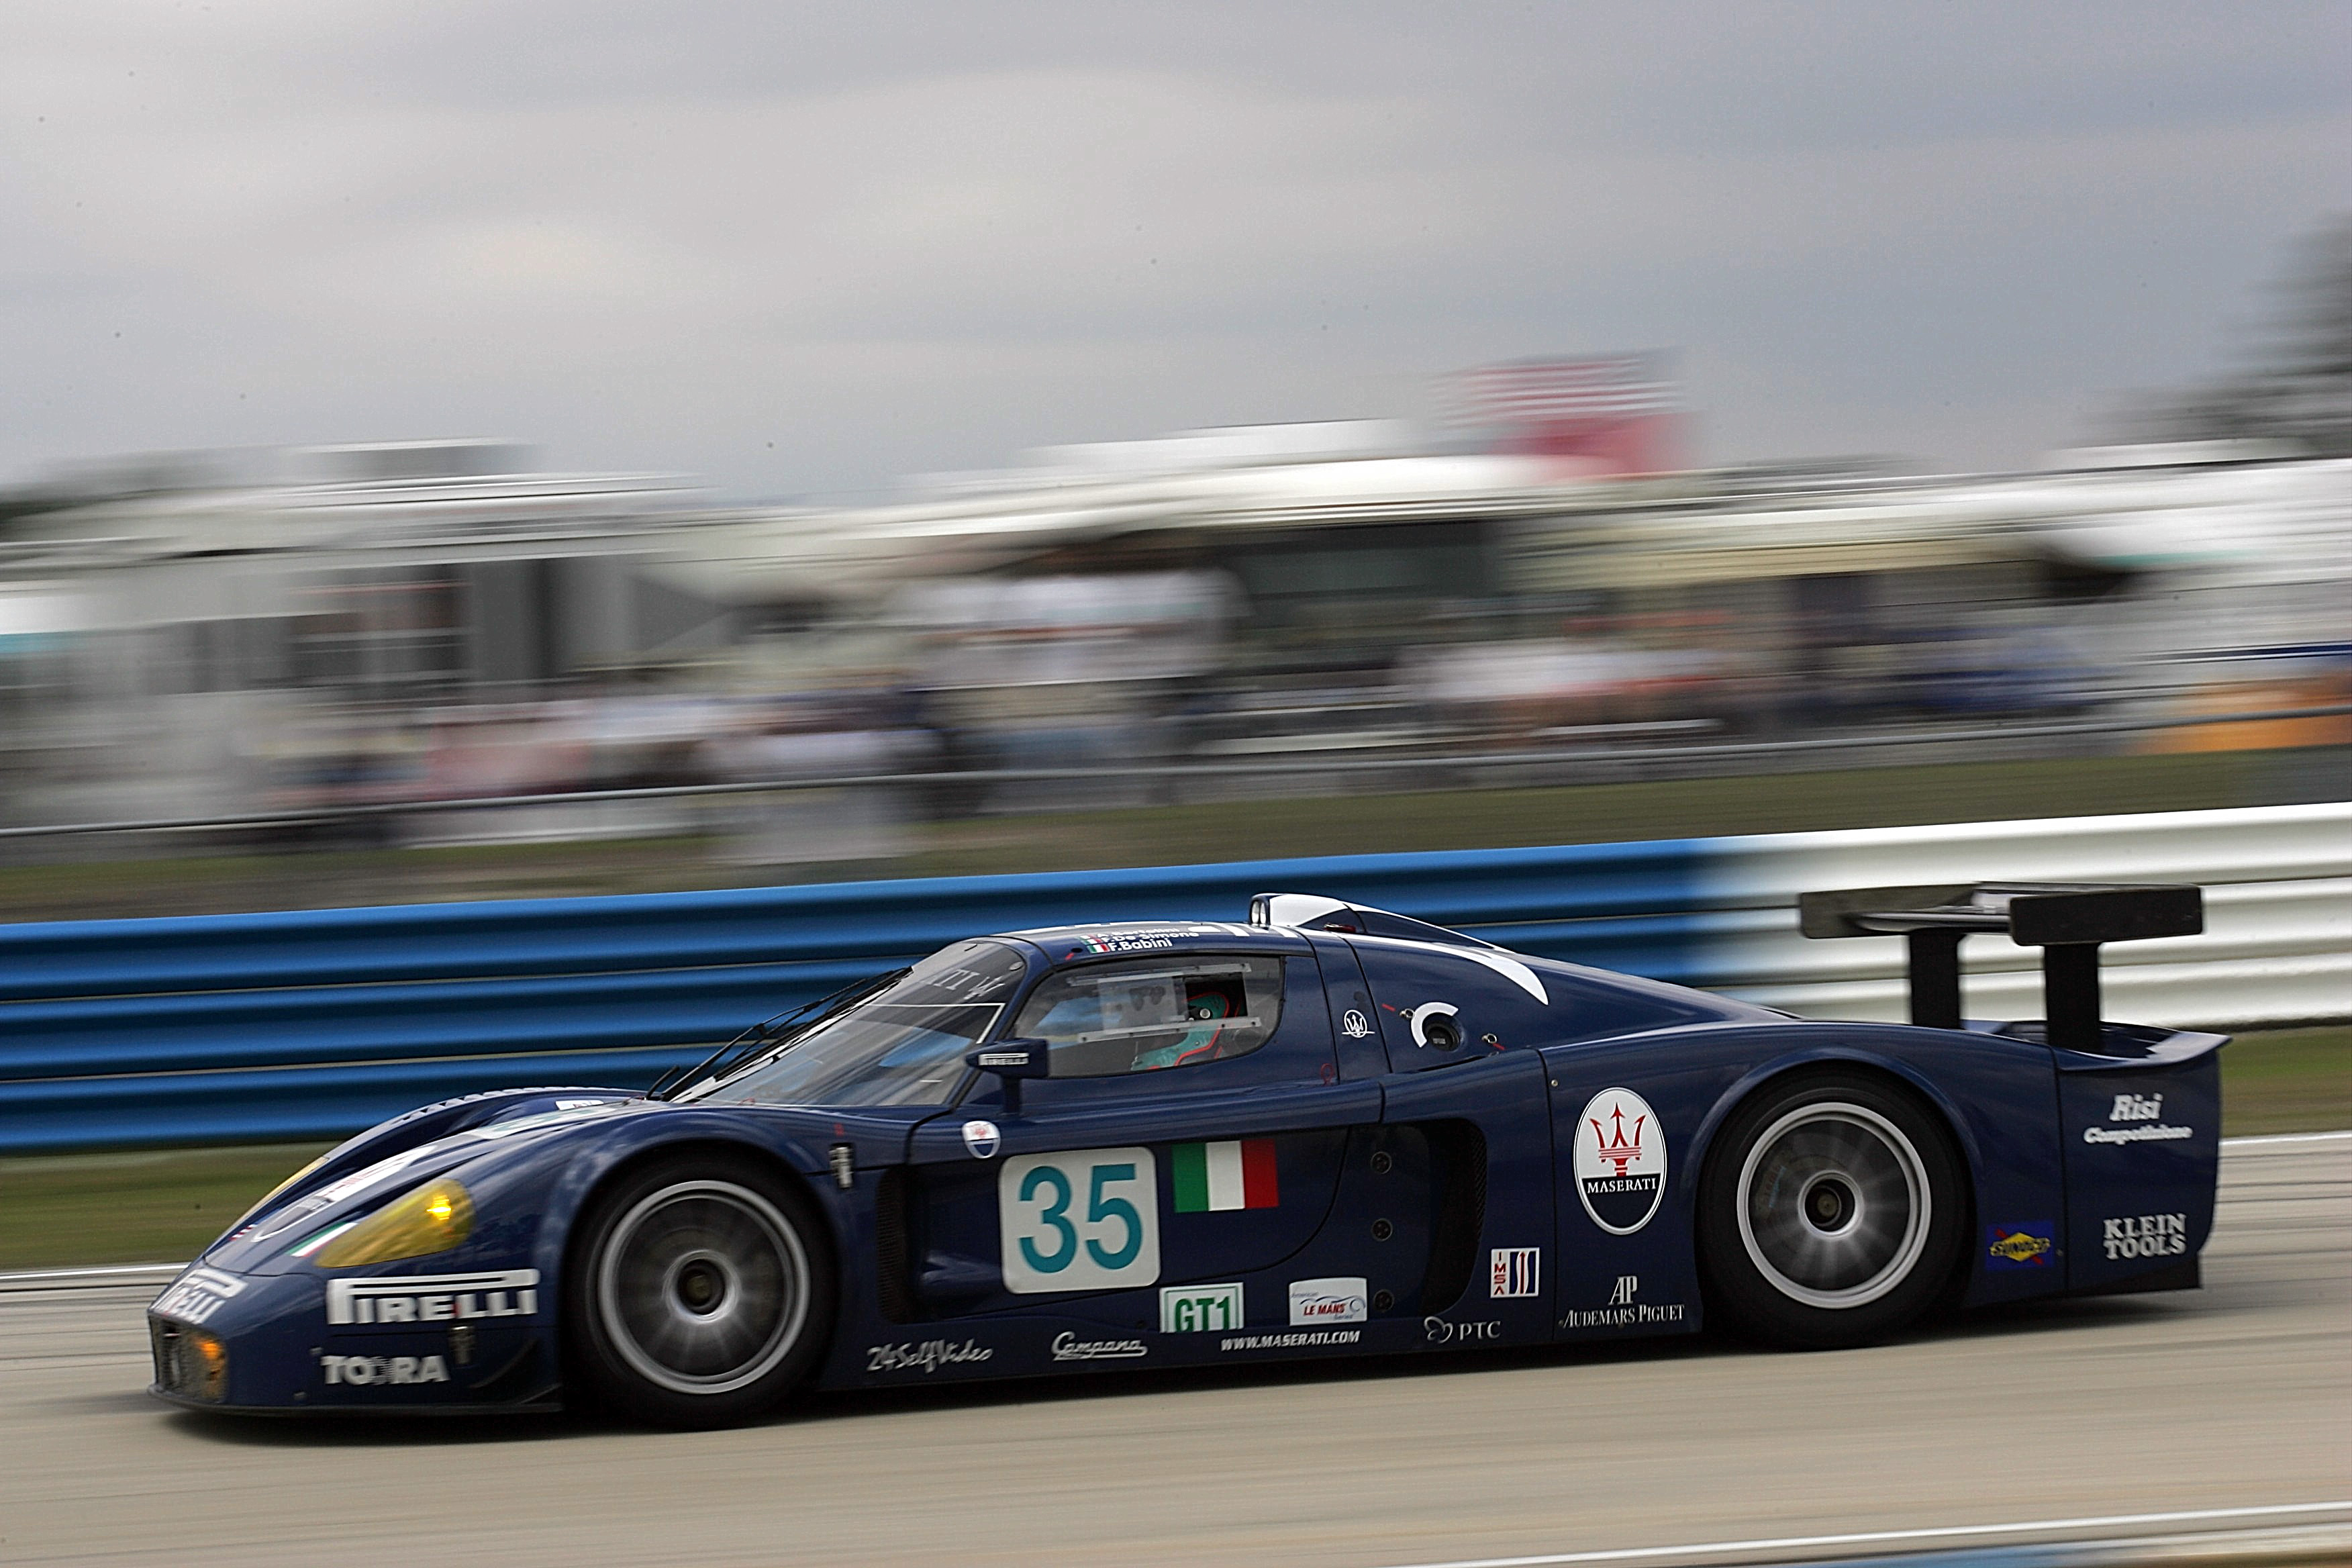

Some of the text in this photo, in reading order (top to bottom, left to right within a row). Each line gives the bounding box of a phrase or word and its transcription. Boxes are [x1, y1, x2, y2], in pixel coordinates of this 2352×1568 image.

[1108, 938, 1173, 952] F.Babini
[1138, 932, 1199, 940] Simone
[2109, 1092, 2164, 1122] Risi
[1587, 1177, 1657, 1194] MASERATI
[1018, 1163, 1144, 1274] 35
[2103, 1213, 2187, 1240] KLEIN
[2103, 1234, 2187, 1260] TOOLS
[1493, 1251, 1507, 1295] IMSA
[326, 1268, 541, 1325] PIRELLI
[1608, 1275, 1638, 1306] AP
[1175, 1295, 1231, 1333] GT1
[1303, 1302, 1347, 1316] LE MANS
[1562, 1304, 1685, 1329] AUDEMARS PIGUET
[1220, 1330, 1361, 1352] WWW.MASERATI.COM
[1459, 1320, 1502, 1341] PTC
[1050, 1330, 1148, 1361] Campana
